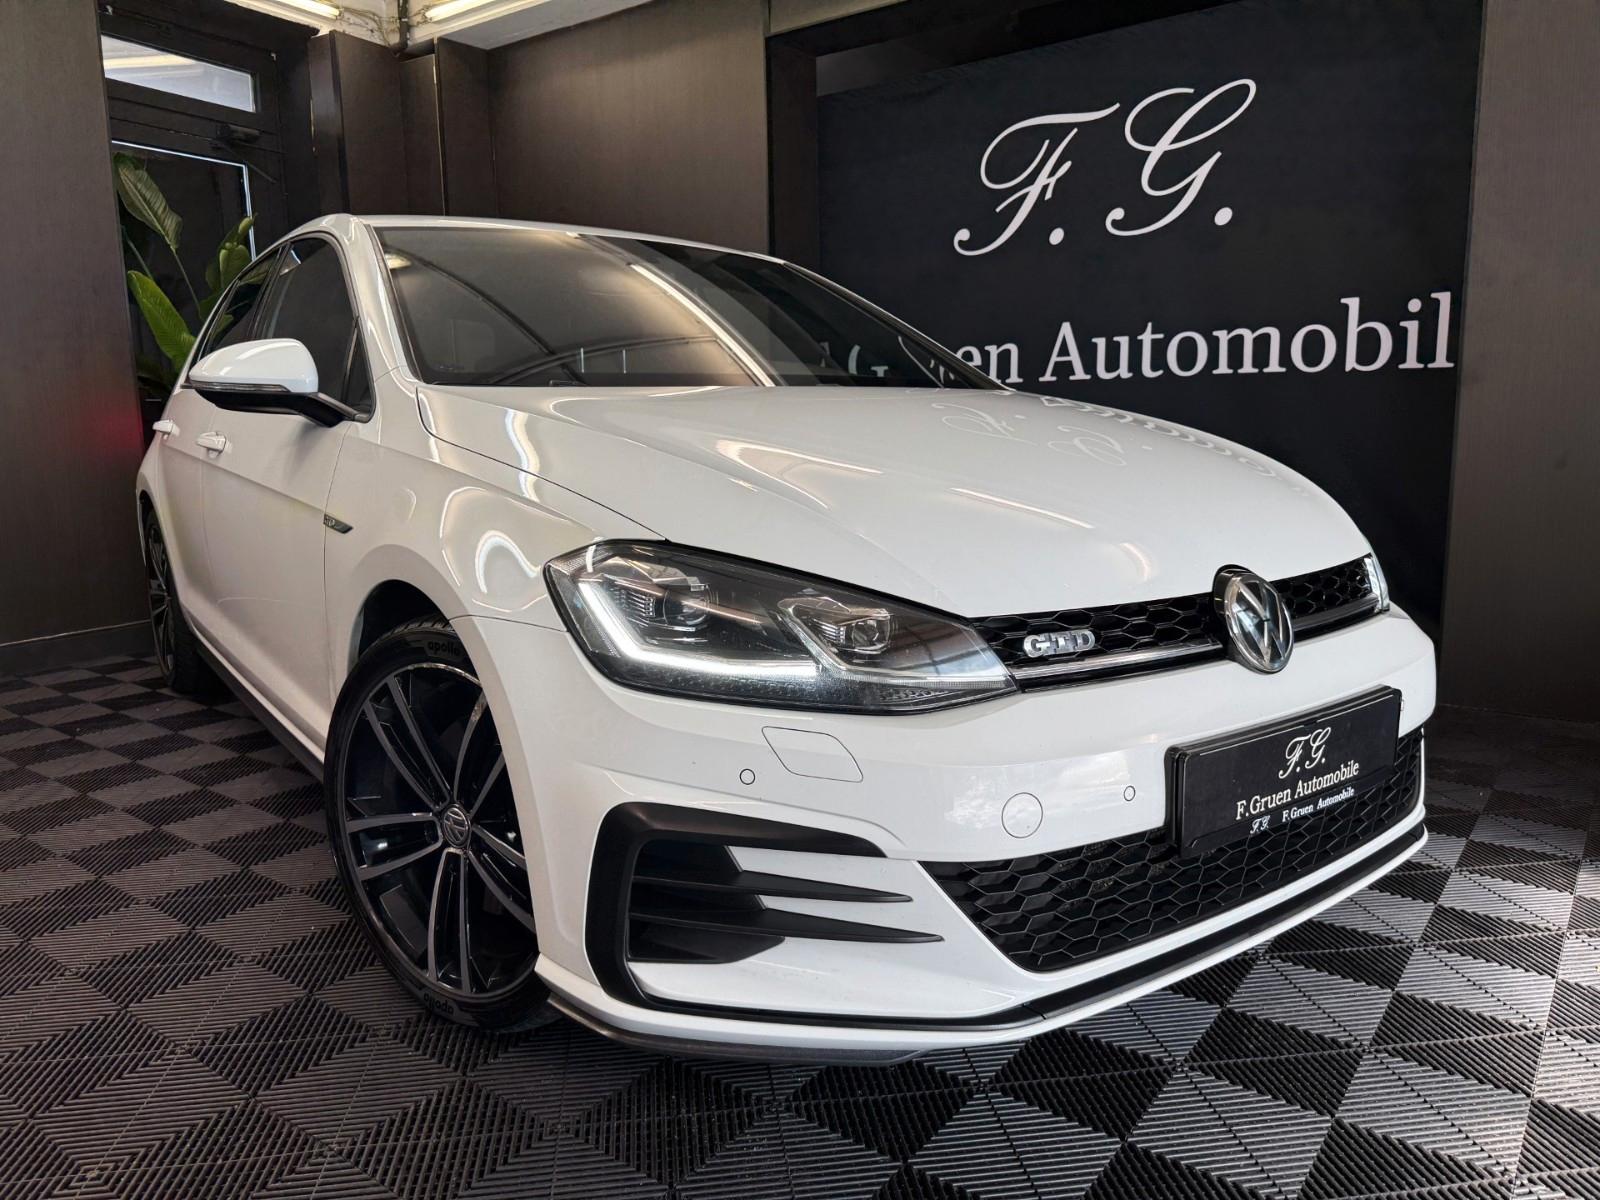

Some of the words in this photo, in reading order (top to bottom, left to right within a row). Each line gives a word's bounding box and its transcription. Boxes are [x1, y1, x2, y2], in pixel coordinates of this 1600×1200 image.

[1038, 291, 1457, 383] Automobil
[1023, 629, 1096, 658] GTD
[1235, 788, 1292, 821] F.Gruen
[1294, 760, 1360, 798] Automobile
[1281, 804, 1314, 823] F.Gruen
[1316, 786, 1355, 810] Automobile
